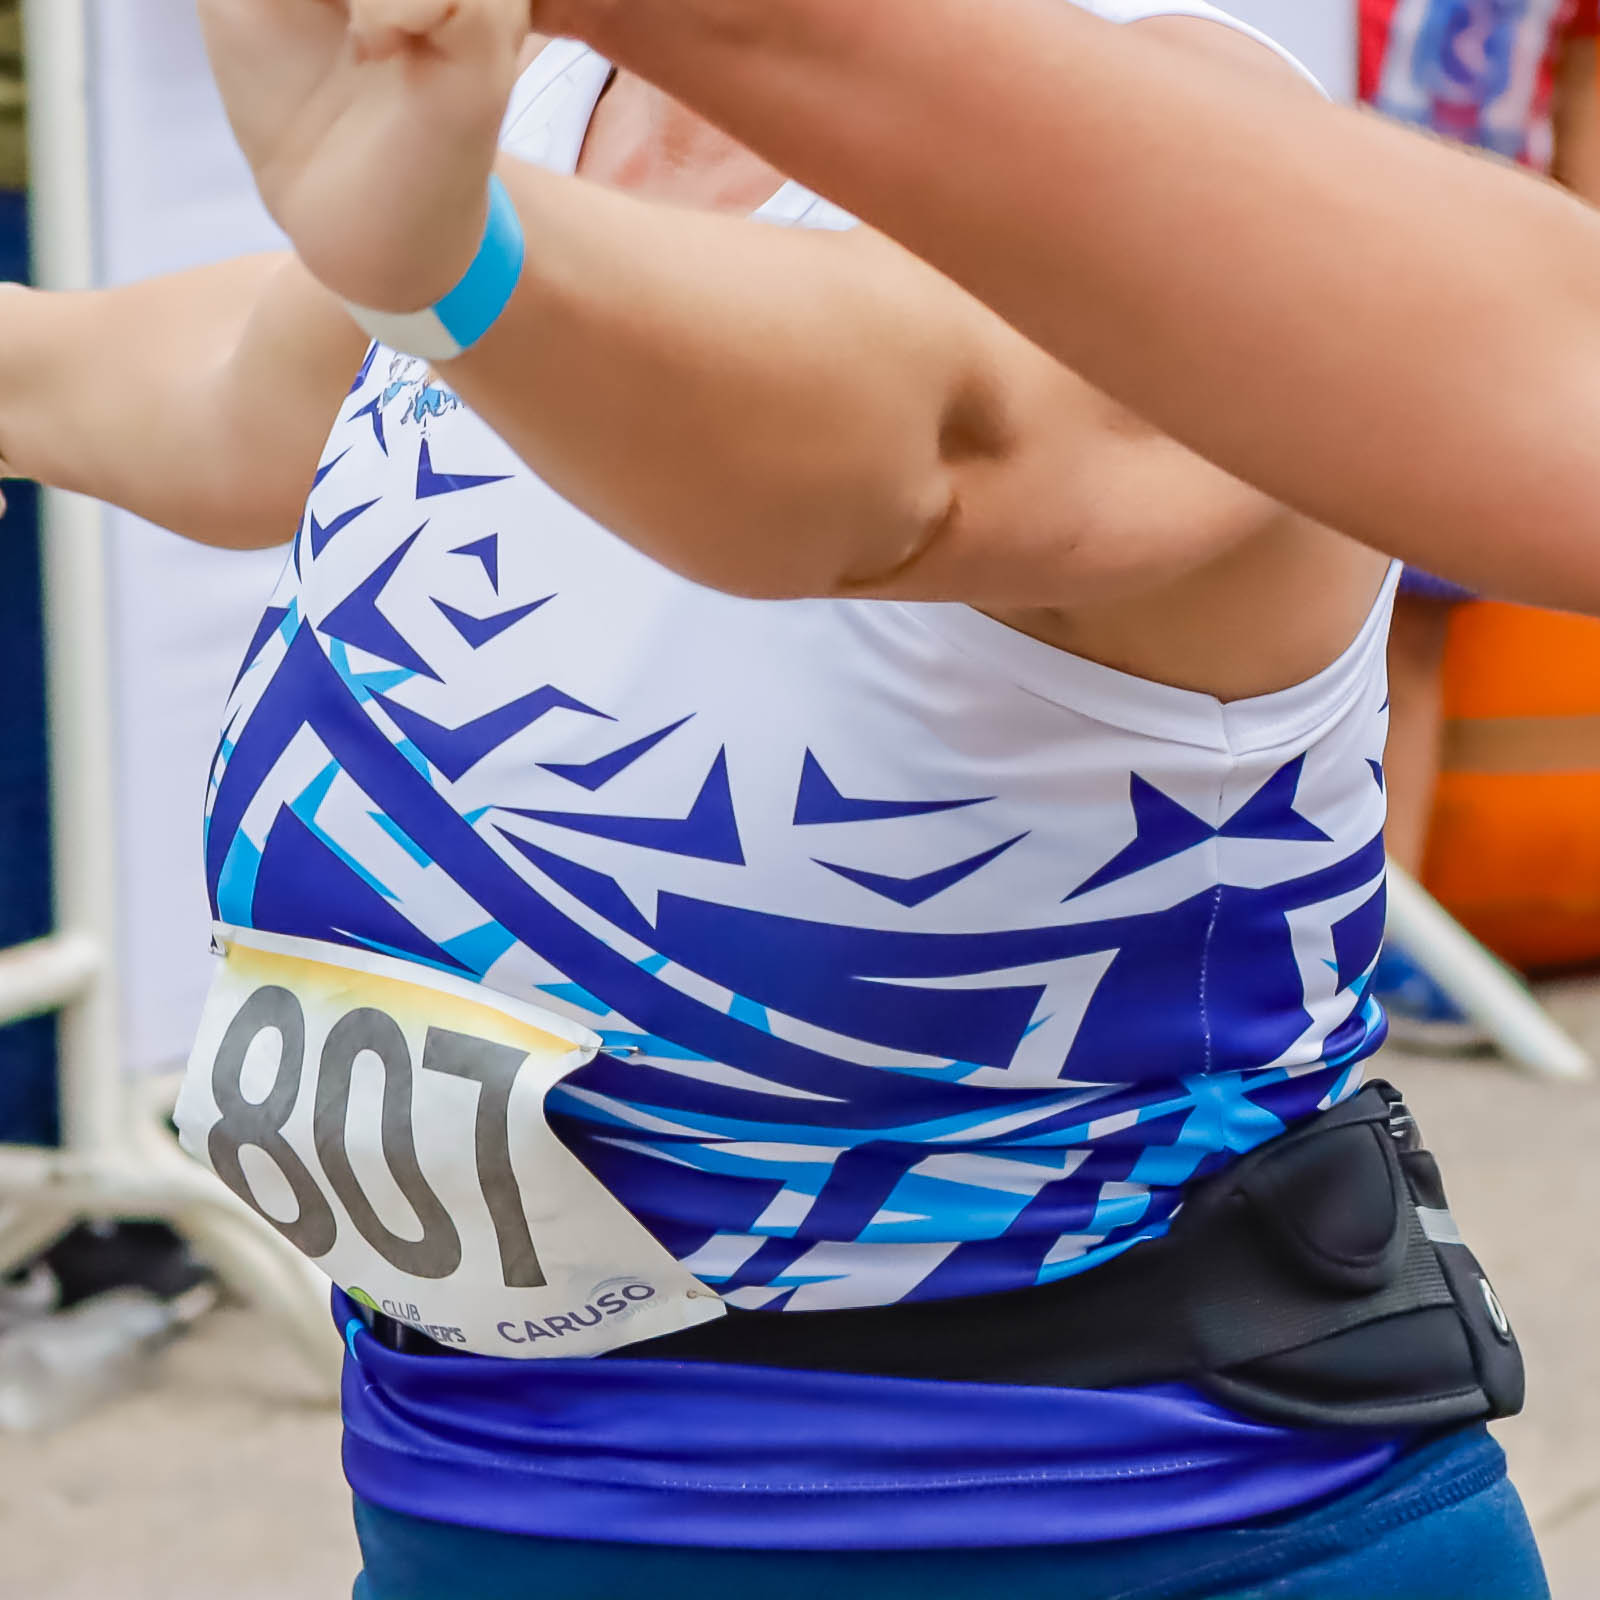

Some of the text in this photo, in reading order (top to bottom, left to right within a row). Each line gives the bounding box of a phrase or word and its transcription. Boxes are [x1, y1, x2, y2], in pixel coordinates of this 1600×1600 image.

[207, 984, 548, 1288] 807
[382, 1299, 421, 1322] CLUB
[496, 1284, 656, 1344] CARUSO
